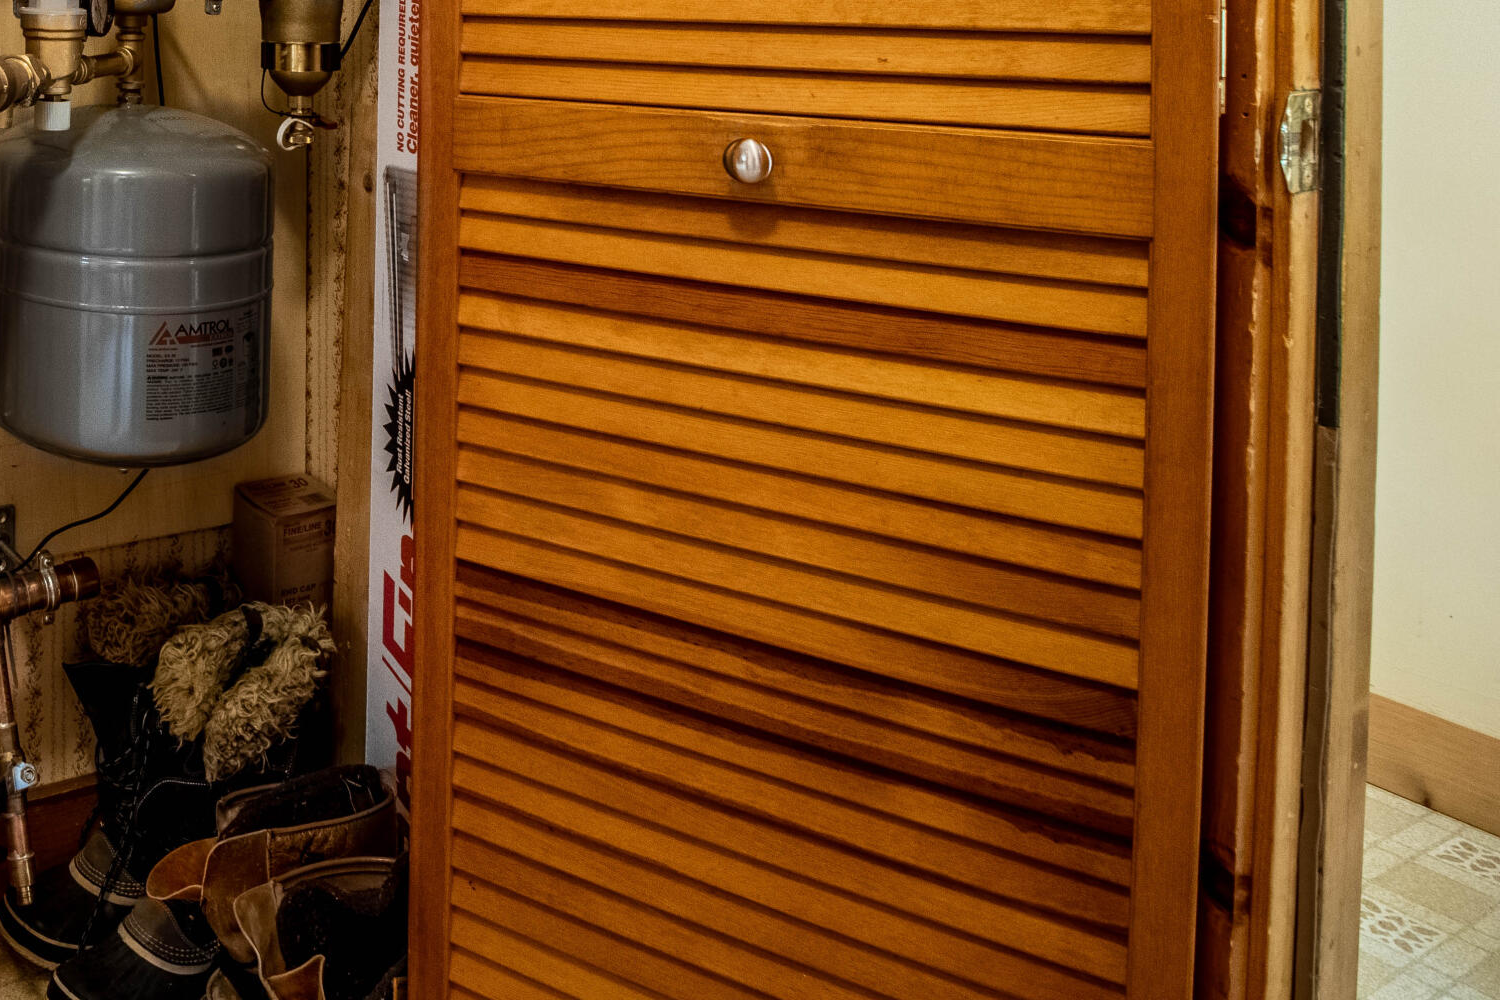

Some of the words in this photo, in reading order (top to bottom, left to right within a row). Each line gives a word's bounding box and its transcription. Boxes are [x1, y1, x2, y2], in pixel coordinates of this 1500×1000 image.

[397, 68, 406, 128] CUTTING
[406, 71, 419, 155] Cleaner,
[396, 132, 405, 152] NO
[174, 319, 231, 337] AMTROL
[396, 394, 404, 446] Resistant
[403, 423, 412, 485] Galvanized
[289, 477, 308, 489] 30
[283, 521, 322, 537] FINE/LINE
